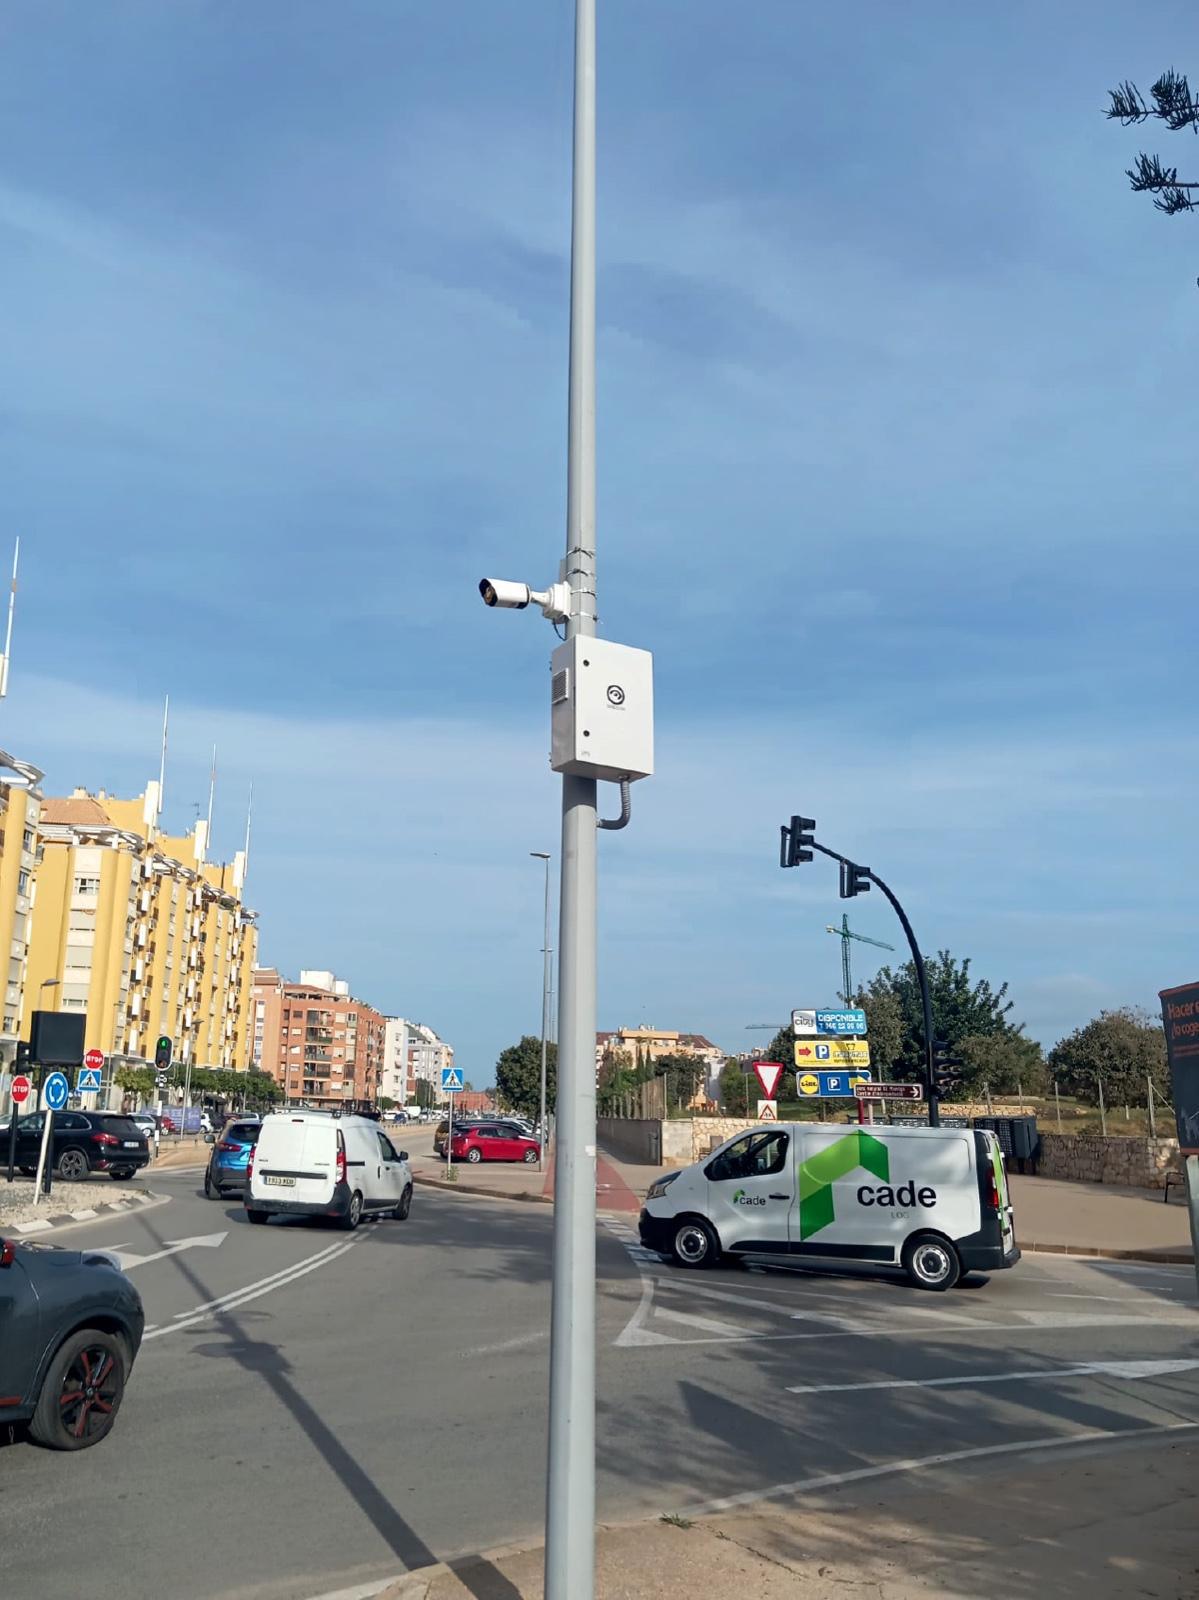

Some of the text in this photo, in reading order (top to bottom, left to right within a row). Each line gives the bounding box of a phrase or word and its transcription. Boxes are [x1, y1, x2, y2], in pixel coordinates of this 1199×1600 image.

[1168, 1002, 1194, 1019] Hacer
[818, 1014, 864, 1022] DISPONIBLE
[86, 1055, 102, 1063] STOP
[857, 1180, 937, 1207] cade
[739, 1194, 766, 1205] cade
